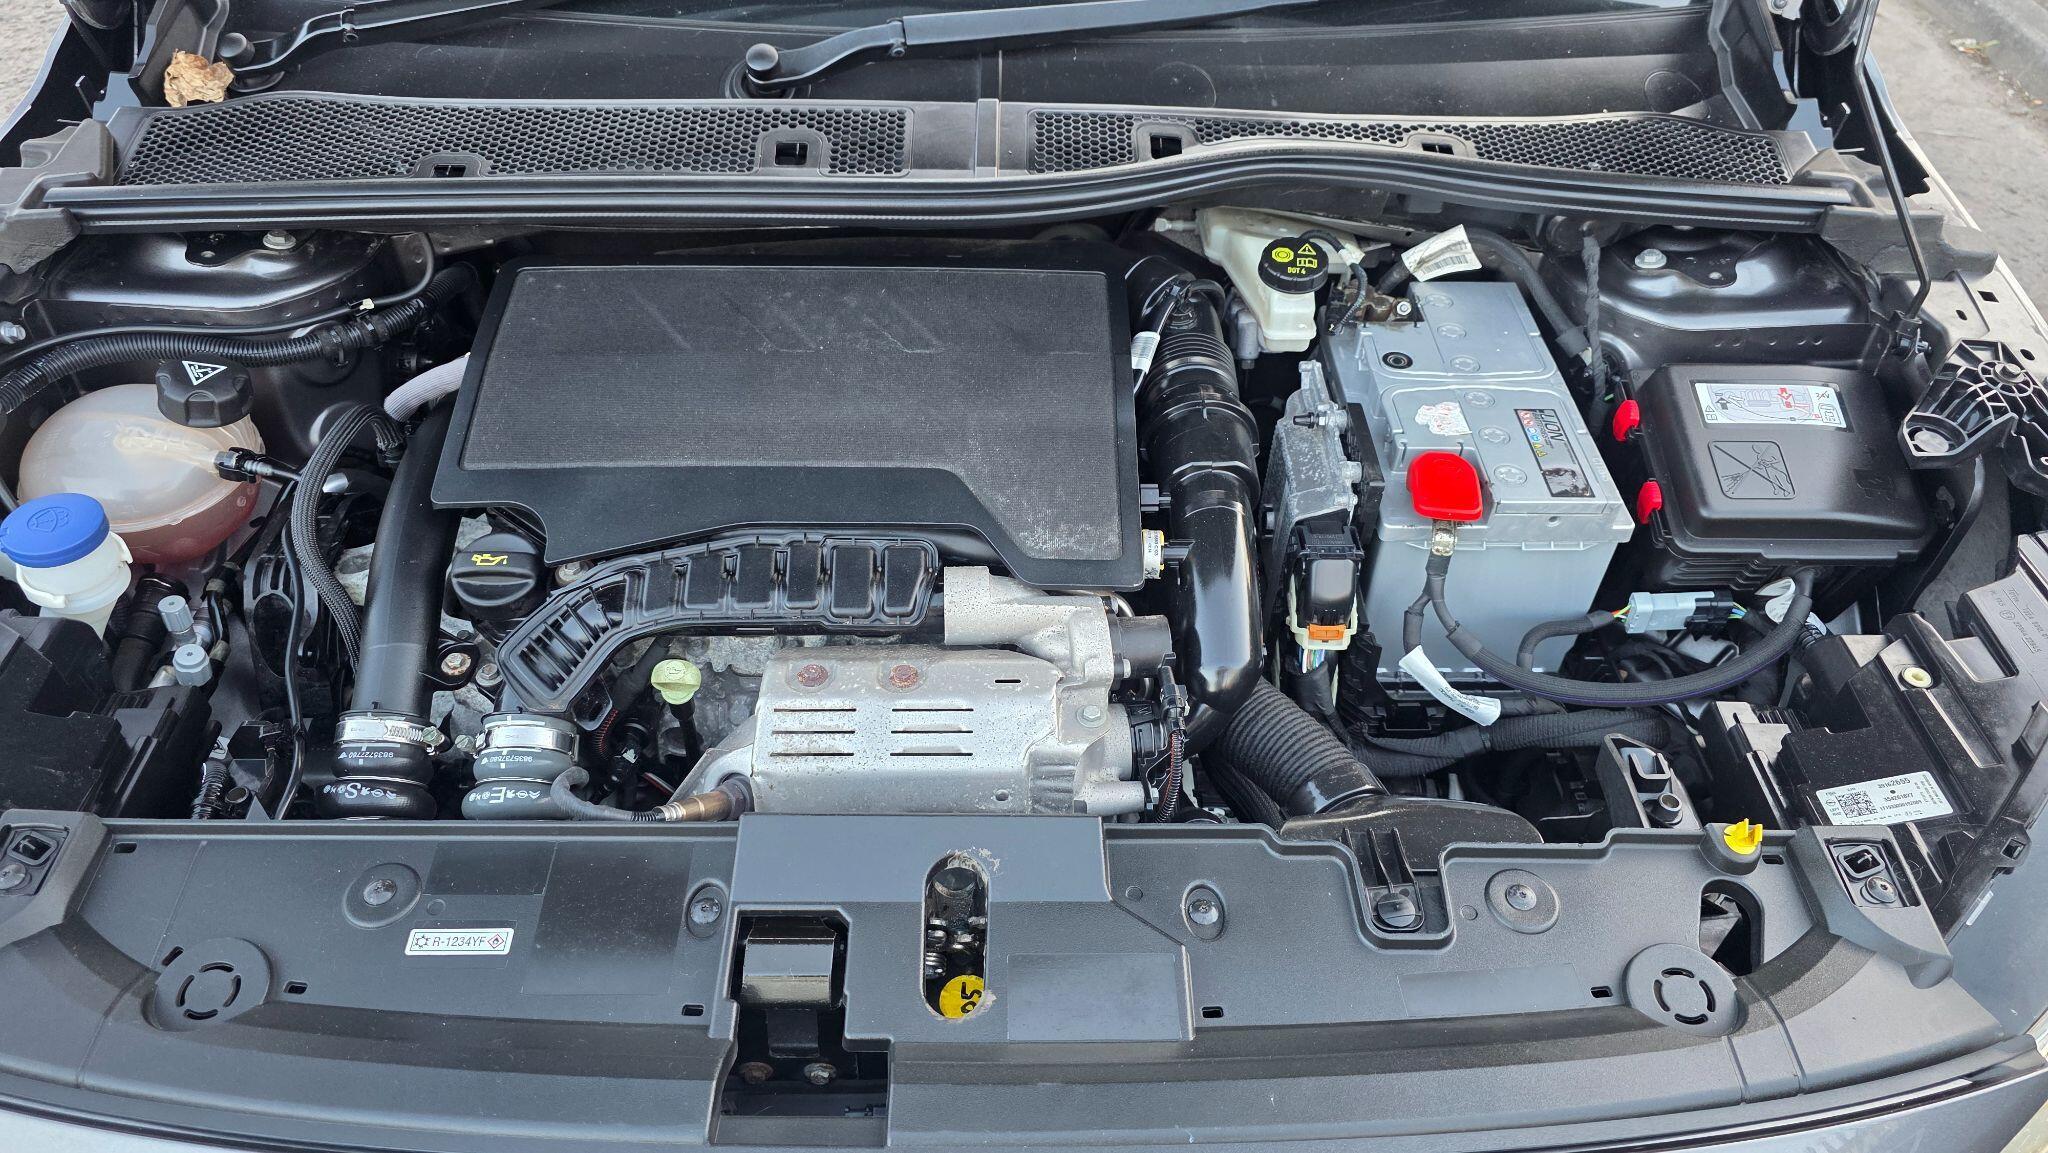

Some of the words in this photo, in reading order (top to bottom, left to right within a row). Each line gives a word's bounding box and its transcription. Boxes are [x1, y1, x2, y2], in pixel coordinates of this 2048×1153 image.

[1287, 266, 1300, 274] DOT
[1541, 412, 1565, 442] LION
[488, 786, 507, 804] E
[432, 936, 487, 947] R-1234YF
